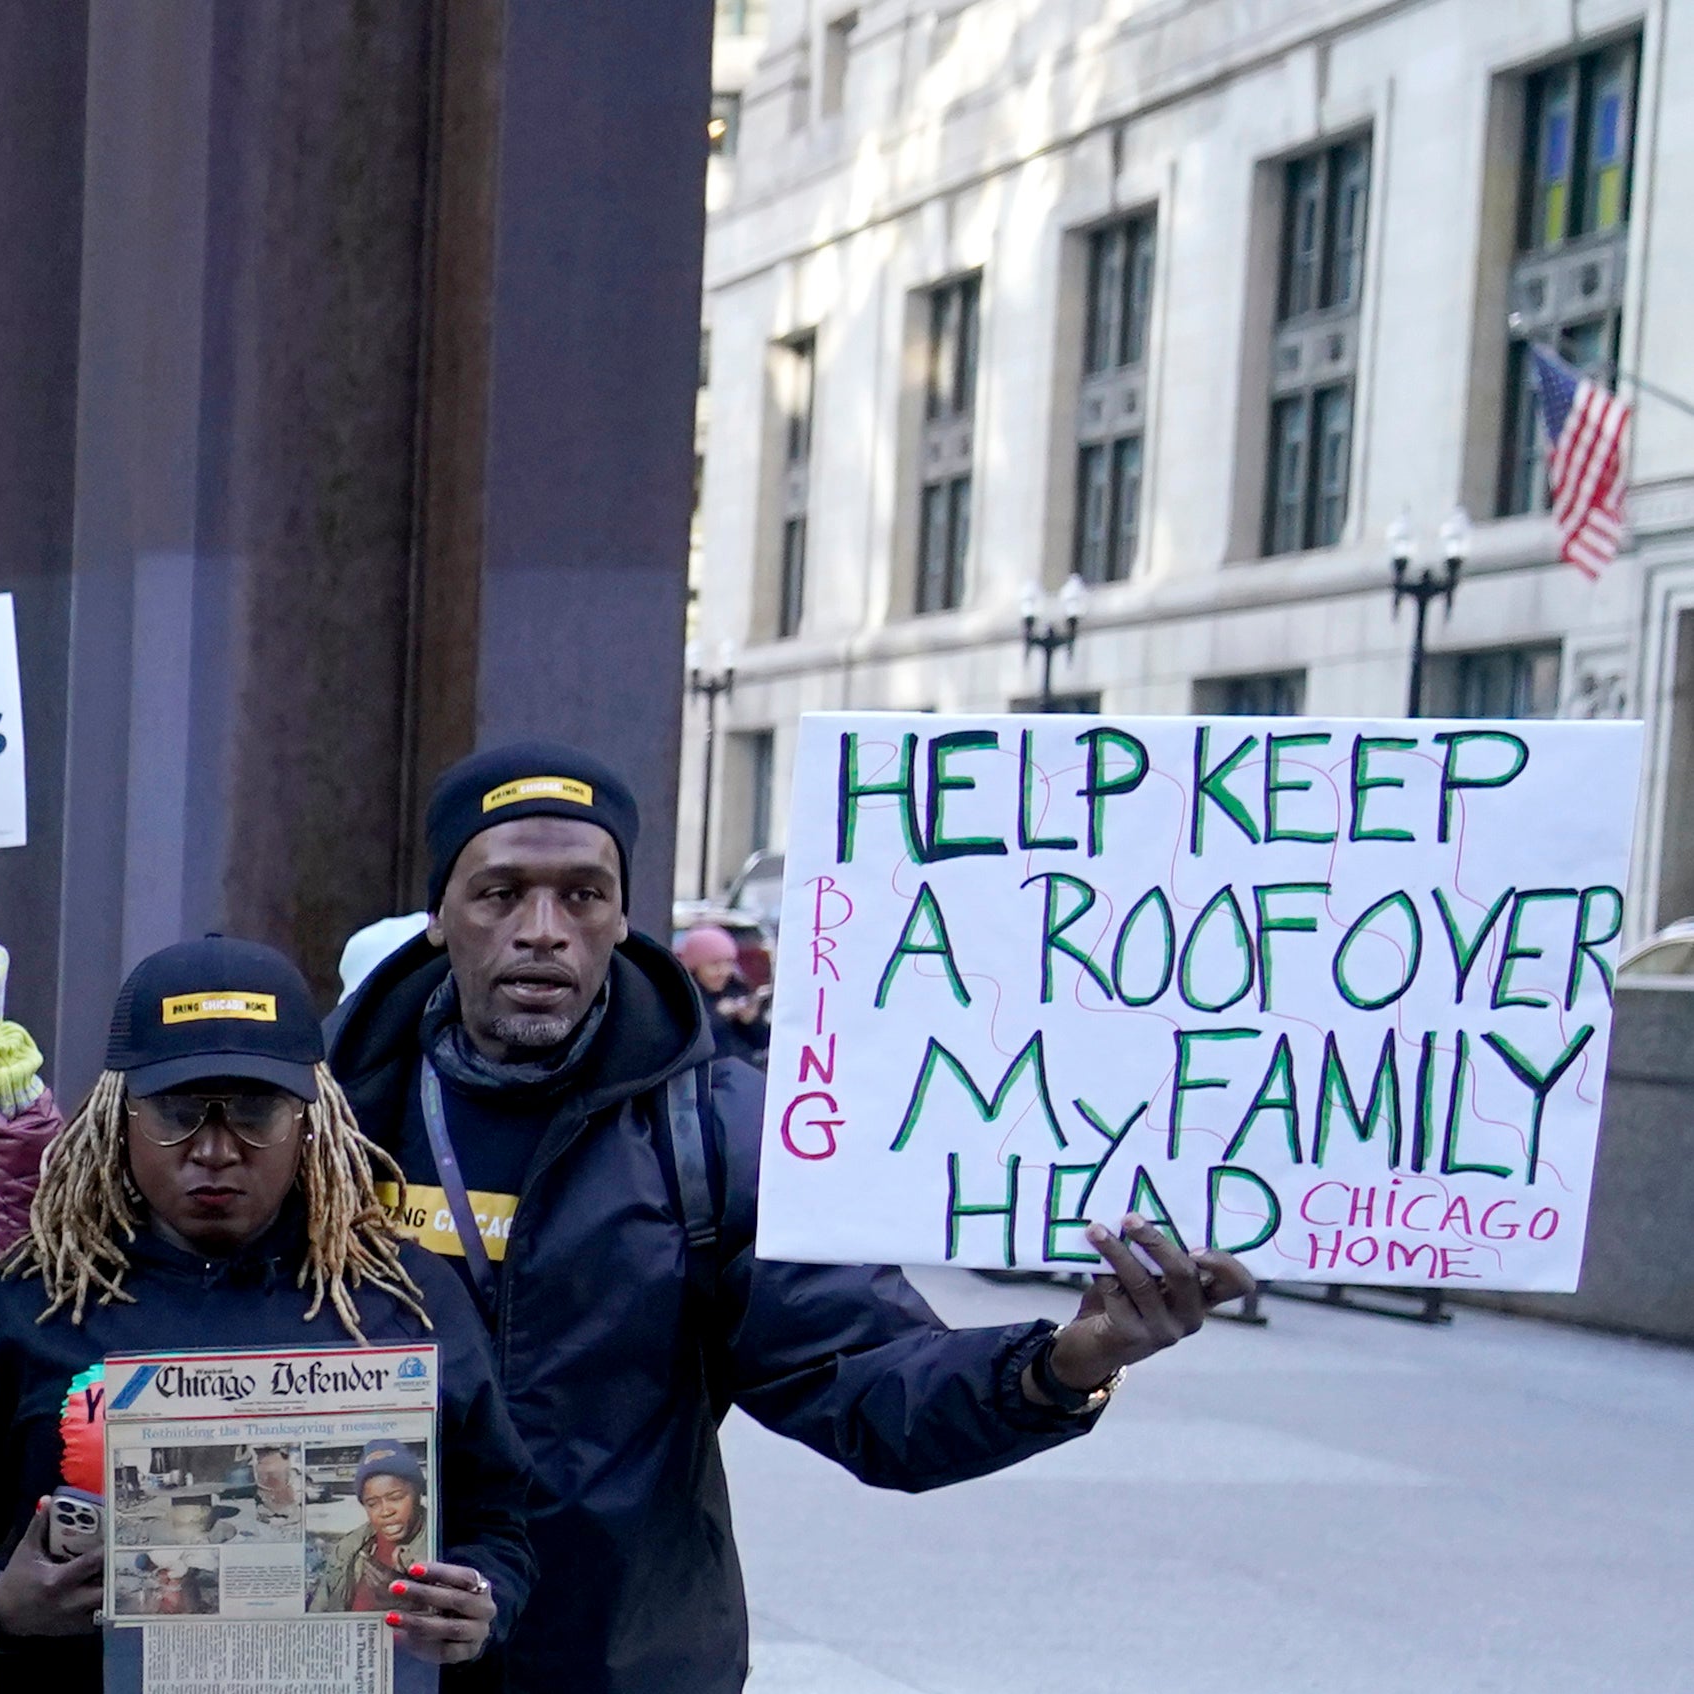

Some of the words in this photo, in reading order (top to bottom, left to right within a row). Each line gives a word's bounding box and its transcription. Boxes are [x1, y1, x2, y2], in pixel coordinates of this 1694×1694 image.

[838, 726, 1149, 865] HELP
[1191, 726, 1529, 856] KEEP
[875, 881, 970, 1008] A
[173, 1003, 199, 1015] BRING
[1168, 1025, 1595, 1185] FAMILY
[946, 1152, 1281, 1267] HEAD
[1307, 1232, 1481, 1281] HOME
[156, 1365, 256, 1401] Chicago
[271, 1360, 389, 1395] Defender
[142, 1426, 215, 1441] Rethinking
[220, 1425, 240, 1437] the
[246, 1421, 335, 1438] Thanksgiving
[341, 1420, 397, 1434] message
